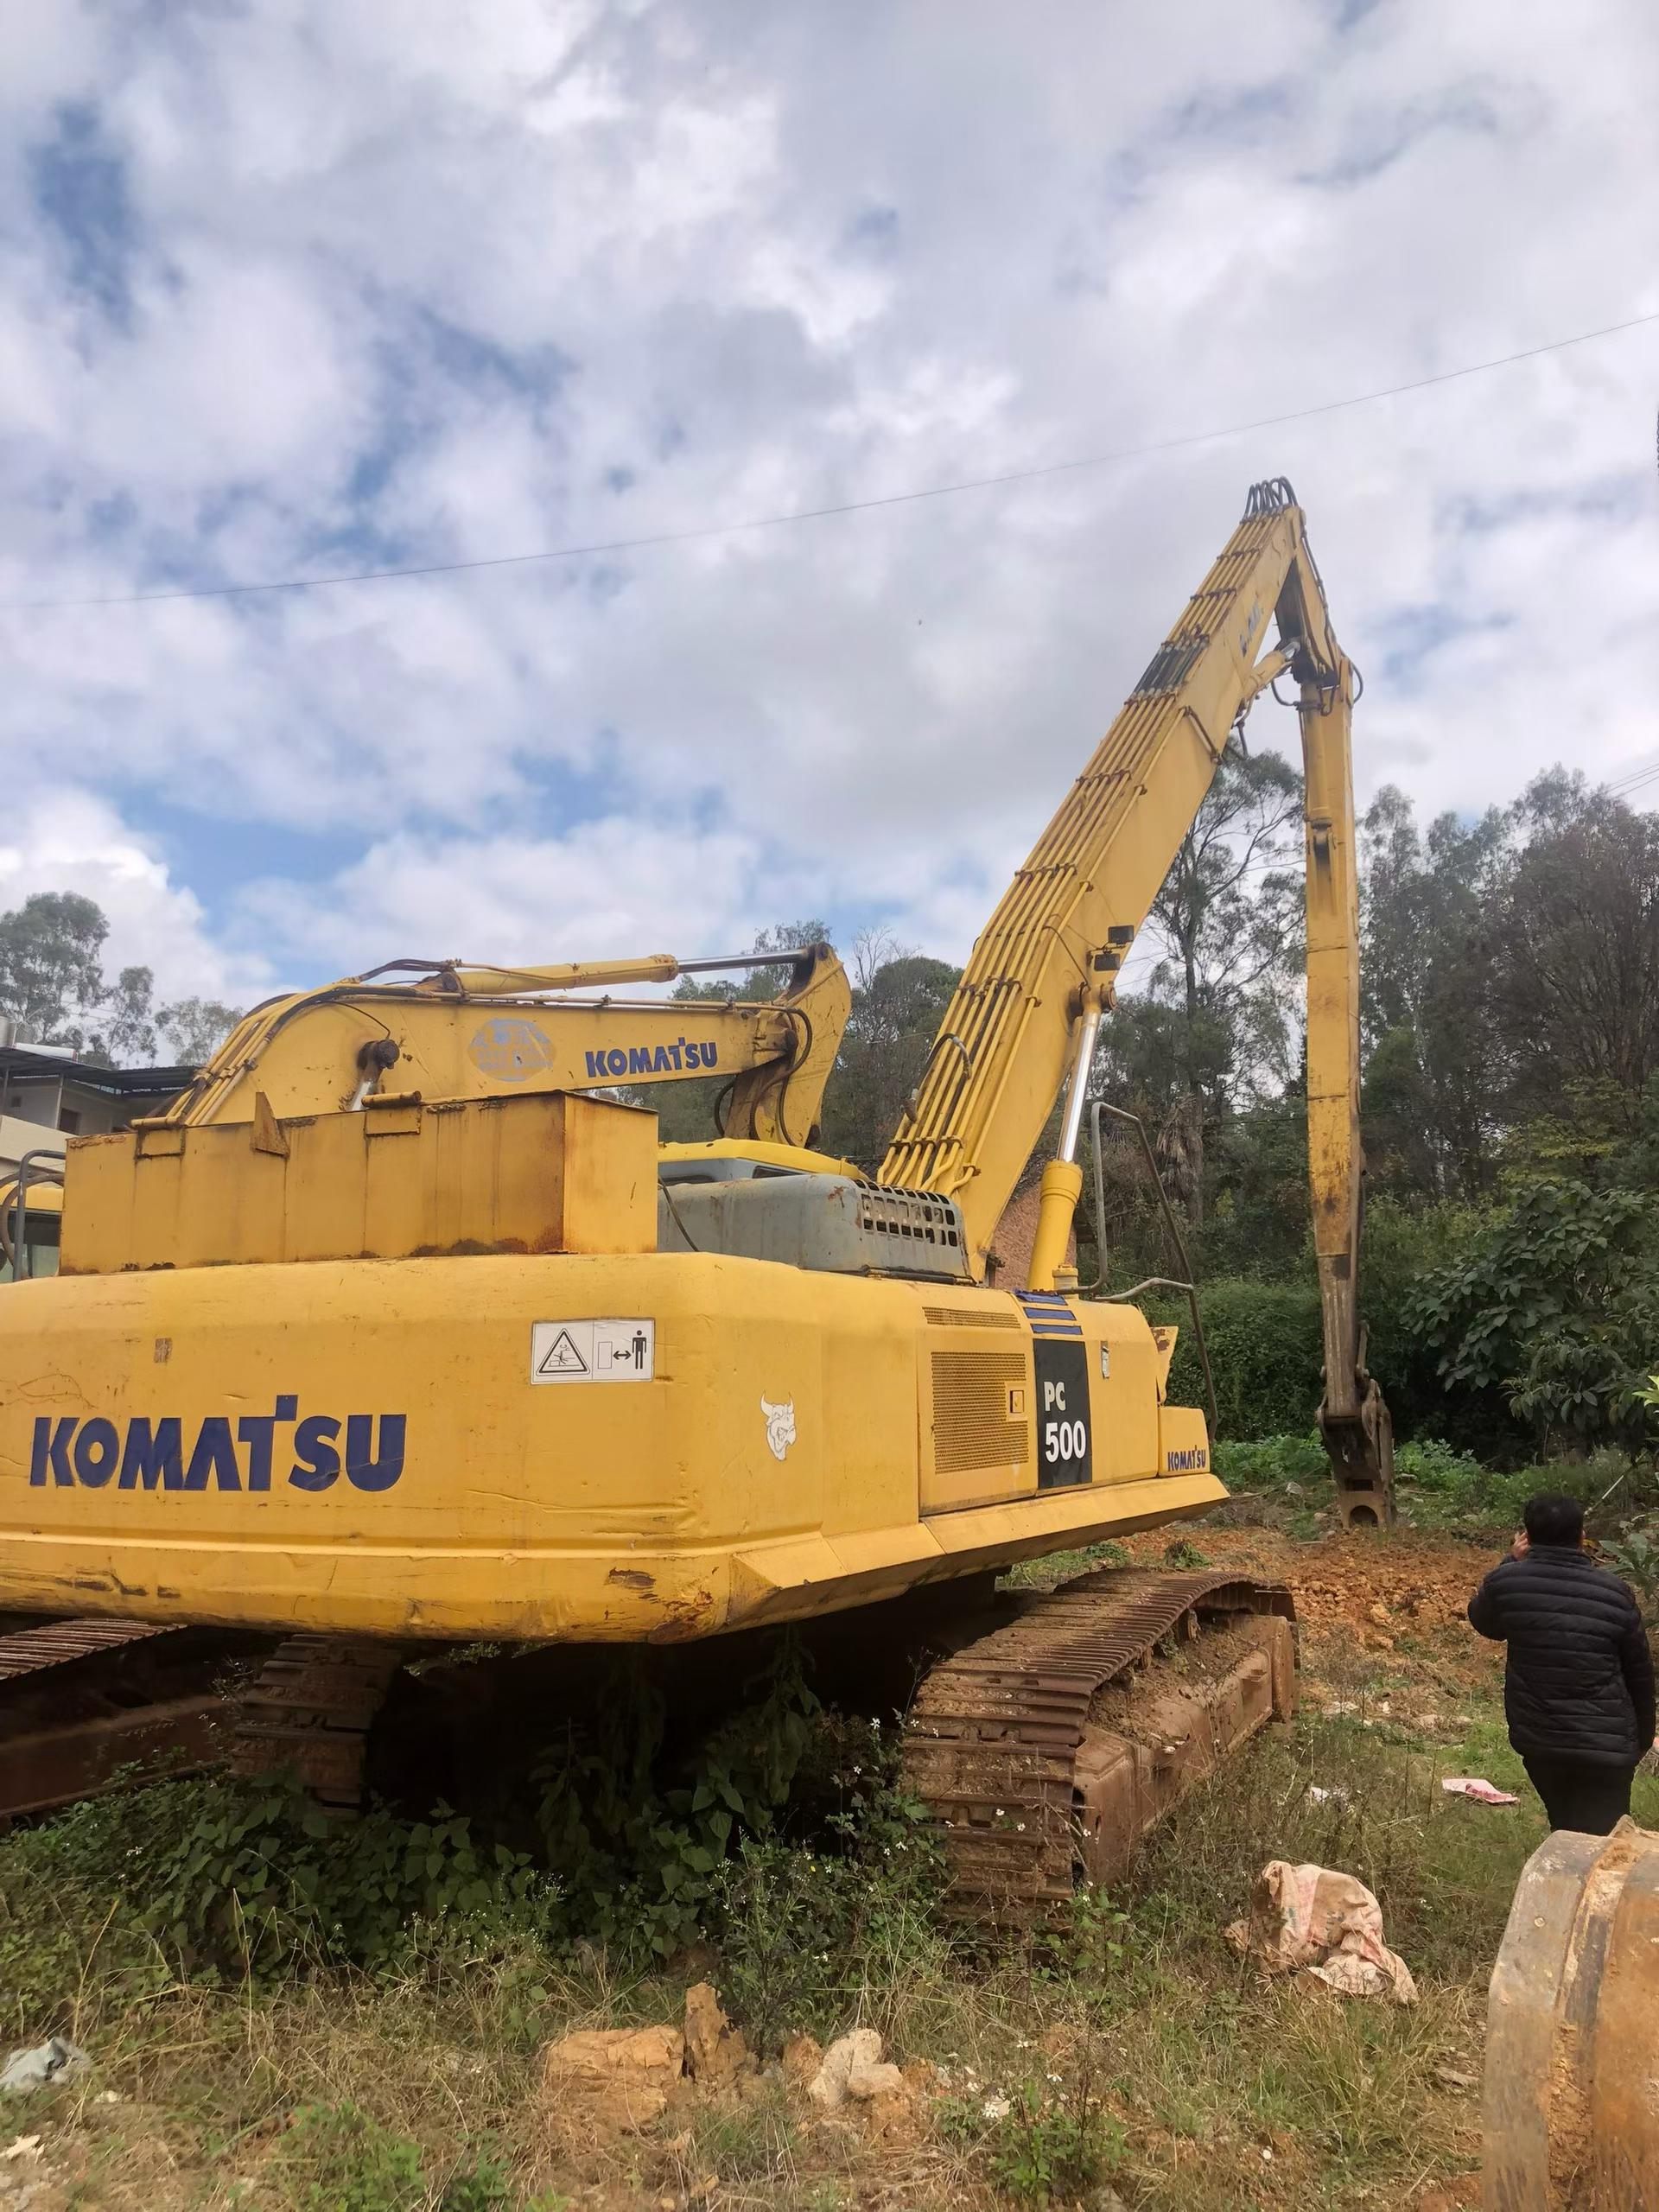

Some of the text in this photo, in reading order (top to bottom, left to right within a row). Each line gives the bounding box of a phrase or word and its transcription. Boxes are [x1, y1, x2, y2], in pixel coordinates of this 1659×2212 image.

[585, 1037, 718, 1078] KOMATSU
[1044, 1381, 1066, 1412] PC
[29, 1395, 407, 1492] KOMATSU
[1045, 1420, 1087, 1463] 500
[1167, 1445, 1206, 1471] KOMATSU
